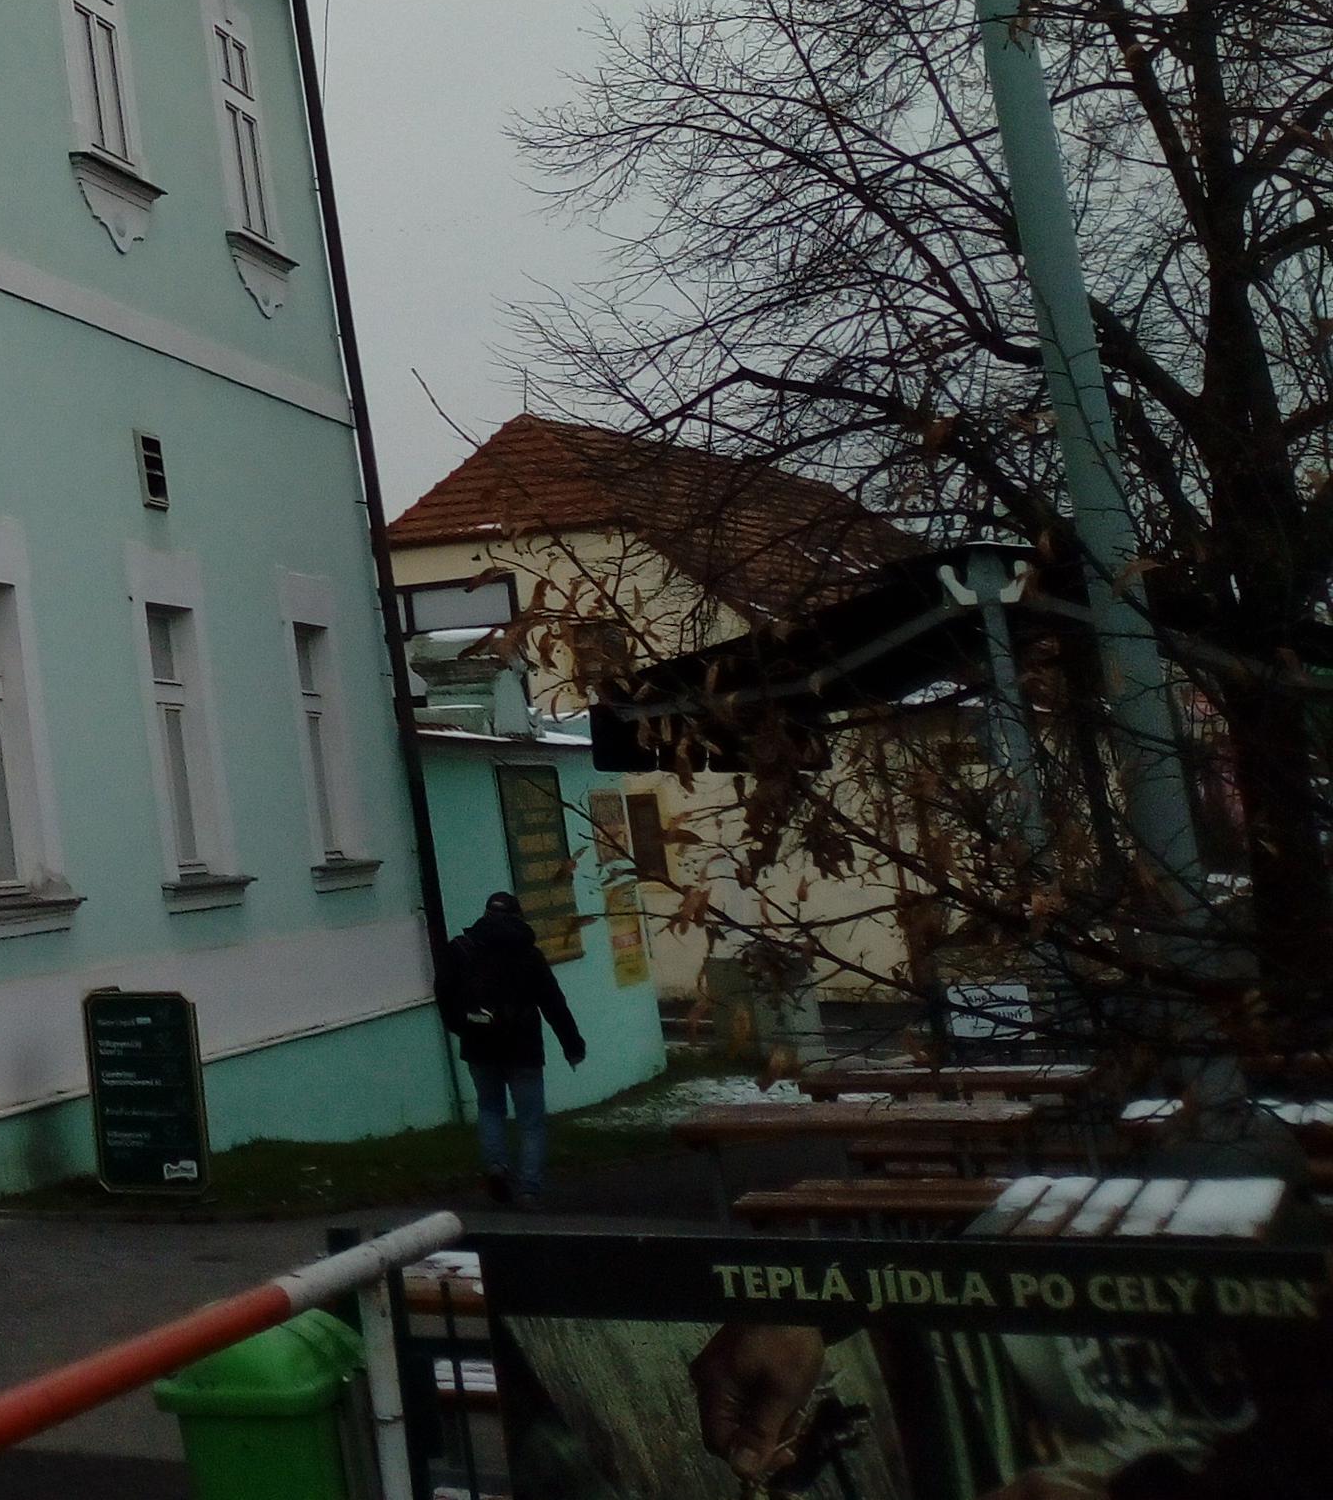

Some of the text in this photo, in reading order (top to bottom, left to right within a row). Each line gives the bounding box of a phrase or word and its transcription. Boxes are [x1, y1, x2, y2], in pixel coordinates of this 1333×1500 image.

[712, 1262, 855, 1303] TEPLÁ
[866, 1262, 995, 1313] JÍDLA
[1010, 1271, 1075, 1311] PO
[1211, 1276, 1319, 1319] DEN
